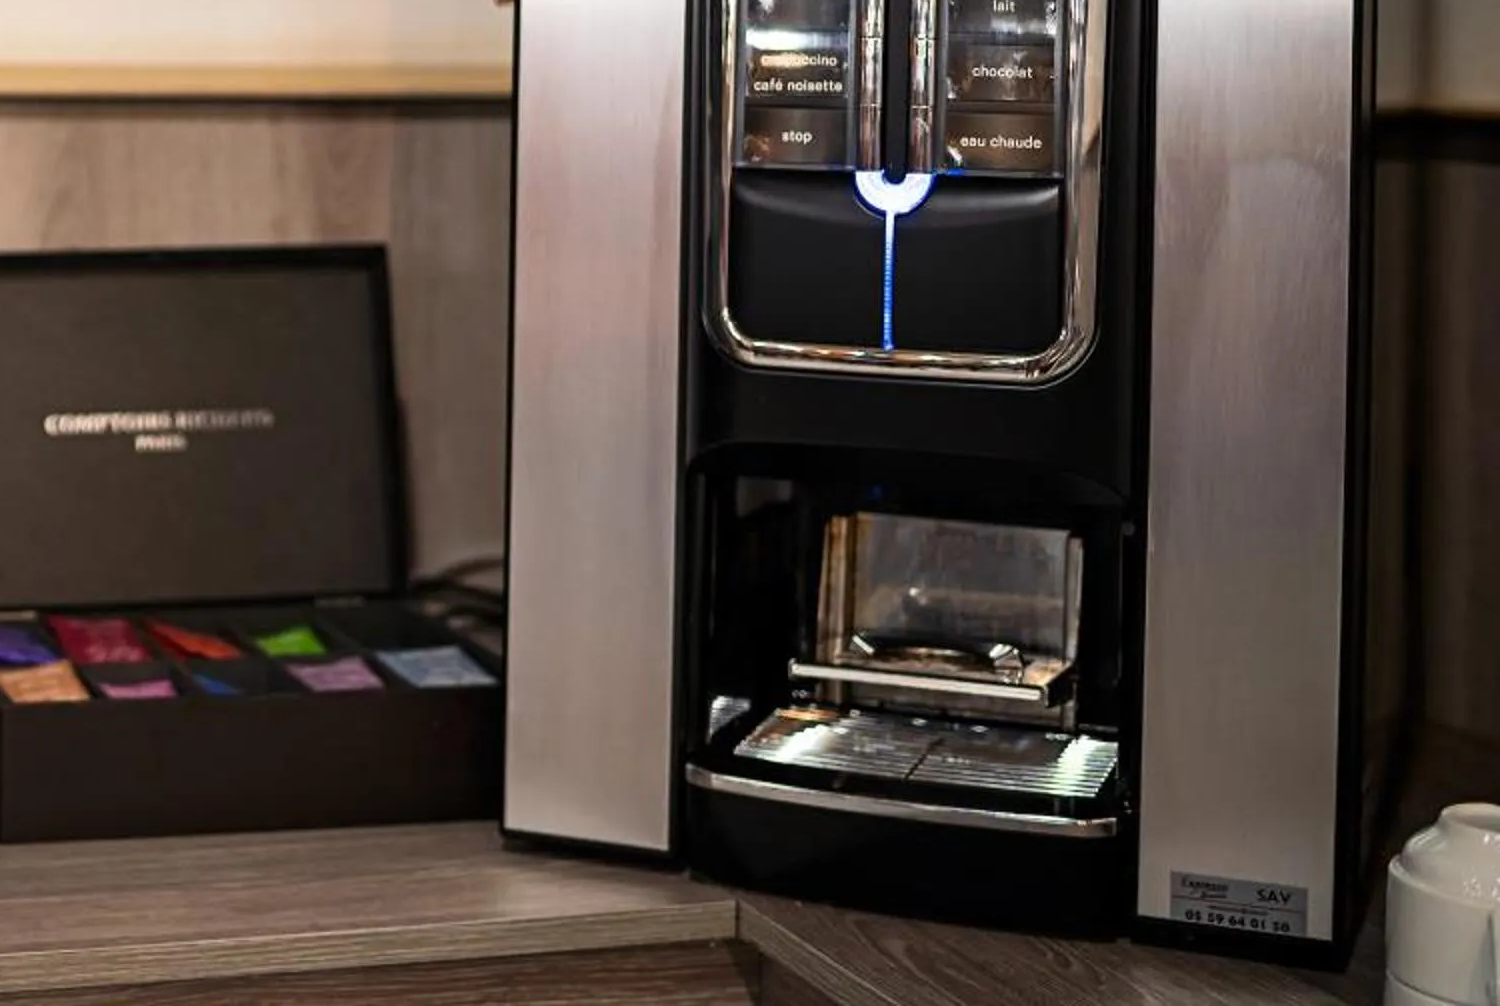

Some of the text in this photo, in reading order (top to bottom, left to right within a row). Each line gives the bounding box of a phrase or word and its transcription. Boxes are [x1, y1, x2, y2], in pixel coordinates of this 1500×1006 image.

[761, 54, 838, 67] cccino
[971, 64, 1033, 79] chocolat
[753, 78, 843, 92] café noisette
[781, 130, 813, 144] stop
[960, 135, 1043, 149] eau chaude
[1256, 888, 1292, 904] SAV
